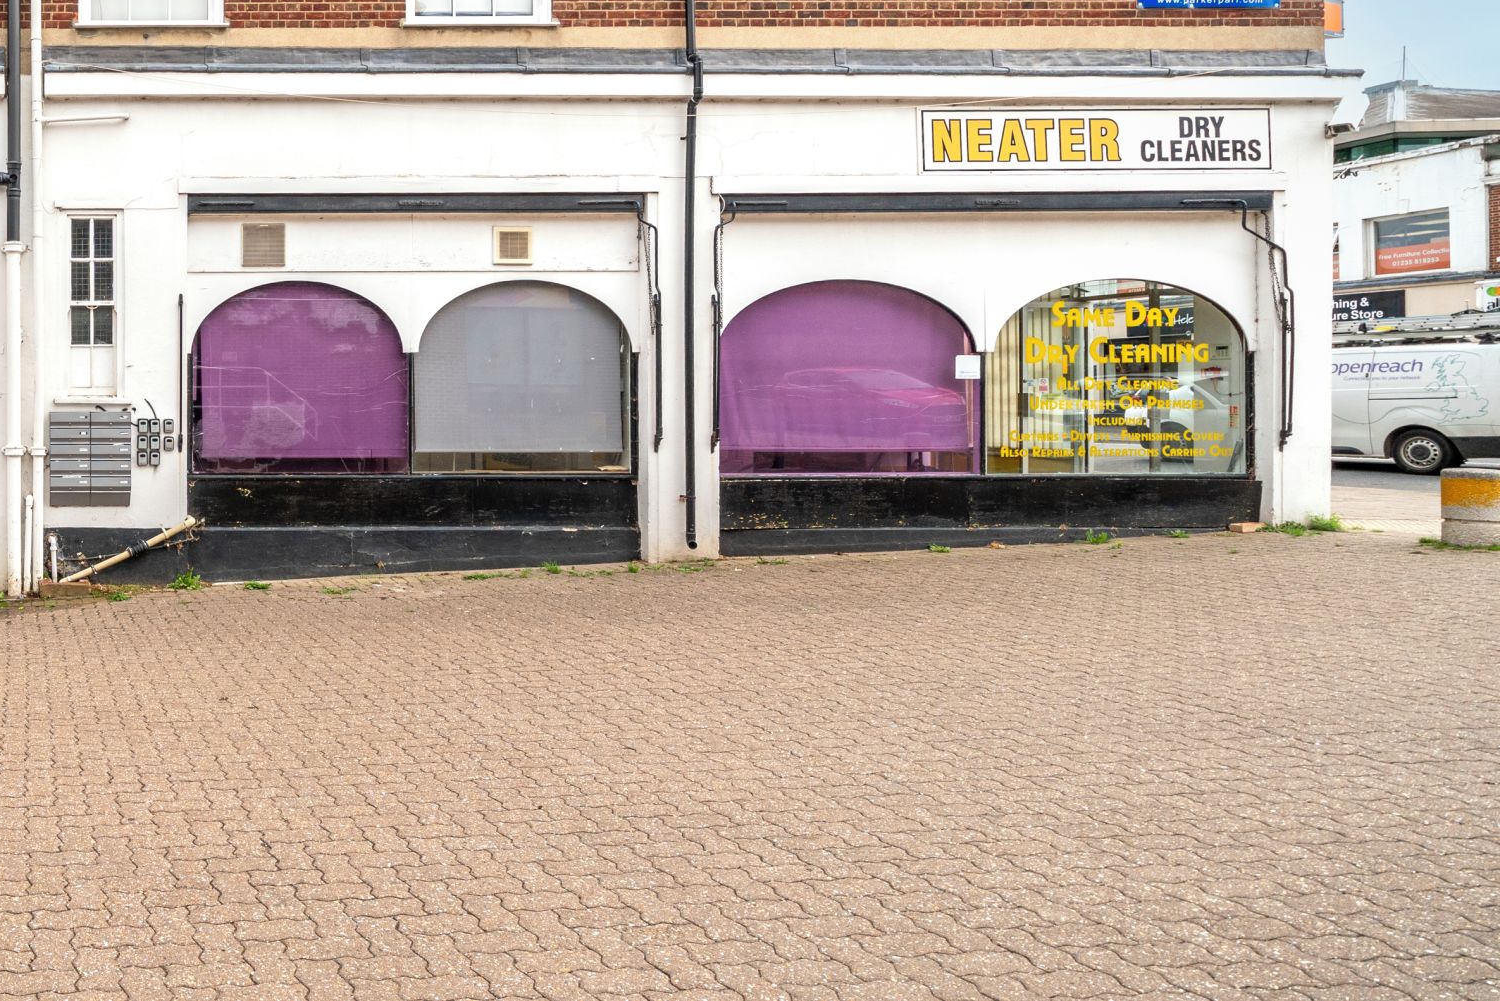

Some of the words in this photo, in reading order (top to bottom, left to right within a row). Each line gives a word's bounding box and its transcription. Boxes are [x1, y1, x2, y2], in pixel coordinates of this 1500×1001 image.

[1178, 116, 1224, 138] DRY
[931, 118, 1122, 162] NEATER
[1140, 140, 1262, 162] CLEANERS
[1360, 297, 1369, 307] &
[1051, 300, 1114, 327] SAME
[1125, 300, 1179, 327] DAY
[1350, 310, 1384, 319] Store
[1025, 337, 1079, 363] DRY
[1089, 336, 1209, 363] CLEANING
[1332, 359, 1423, 375] openreach
